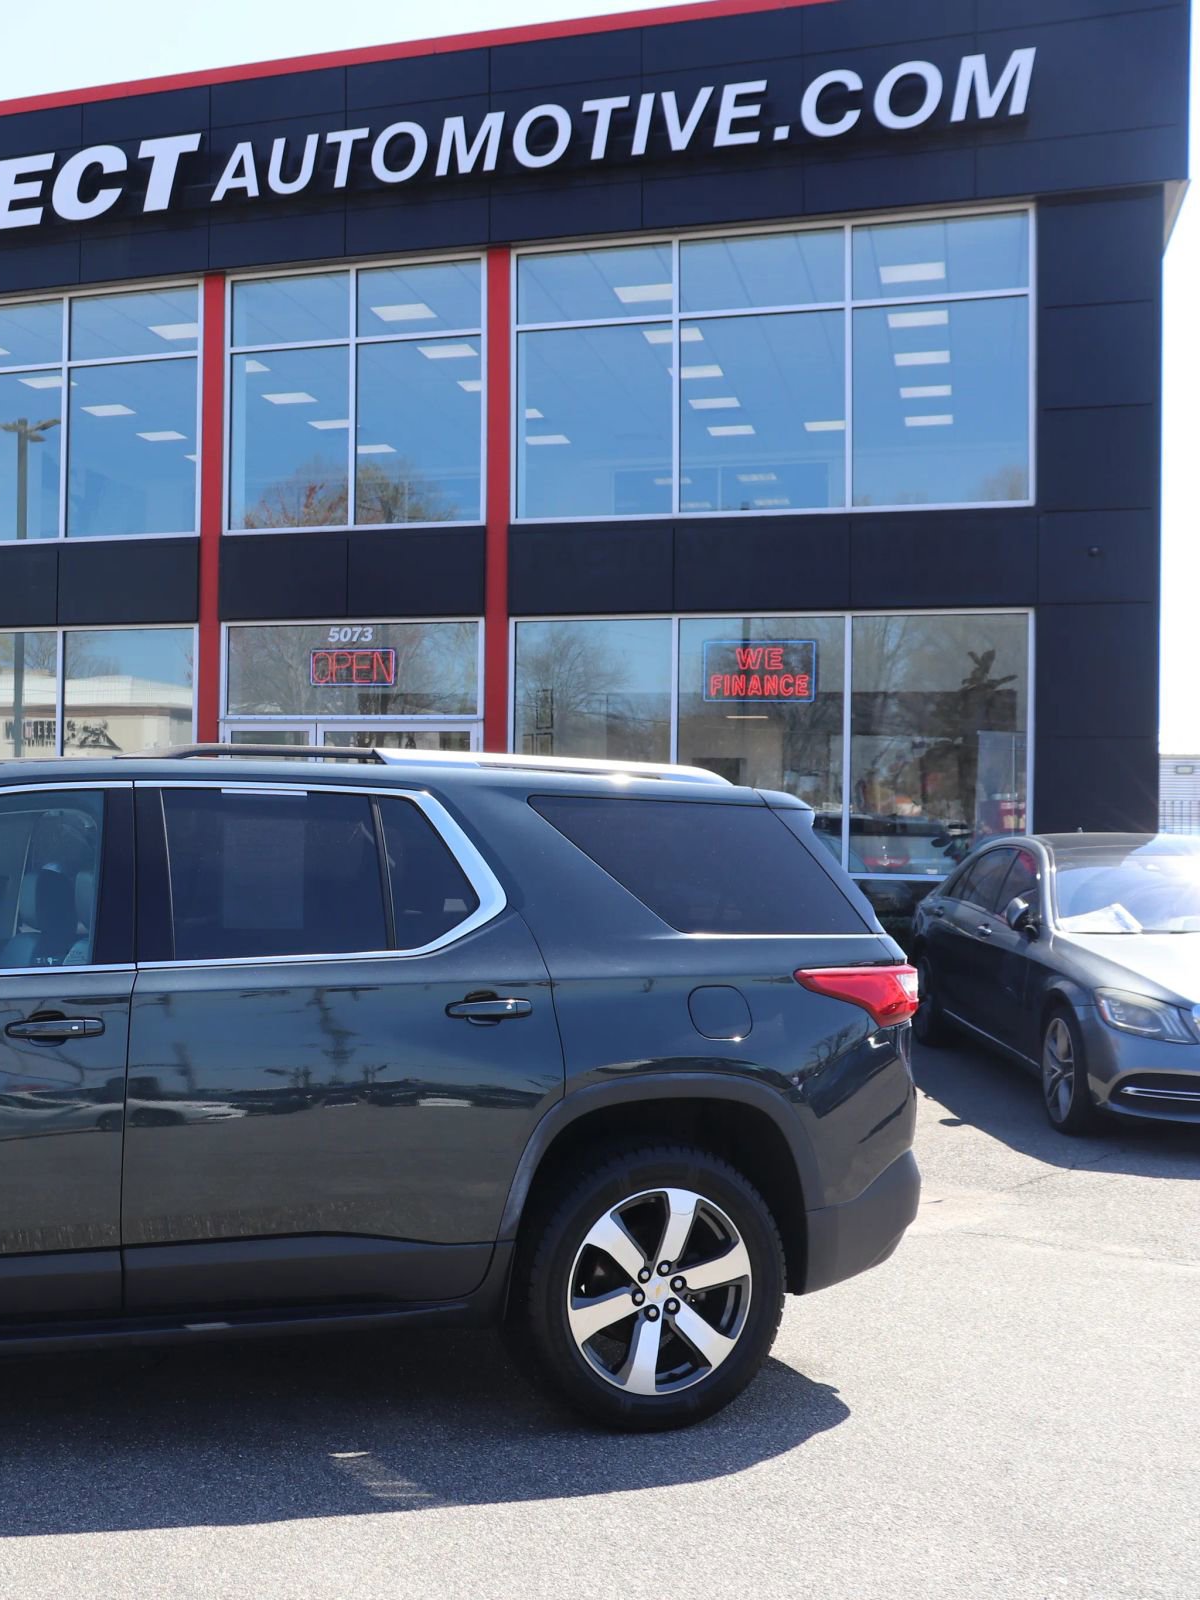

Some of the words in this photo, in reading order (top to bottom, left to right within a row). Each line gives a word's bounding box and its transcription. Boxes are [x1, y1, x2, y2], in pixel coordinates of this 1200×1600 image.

[210, 47, 1038, 202] AUTOMOTIVE.COM
[327, 626, 373, 642] 5073
[313, 652, 393, 683] OPEN
[735, 646, 785, 671] WE
[709, 673, 810, 698] FINANCE
